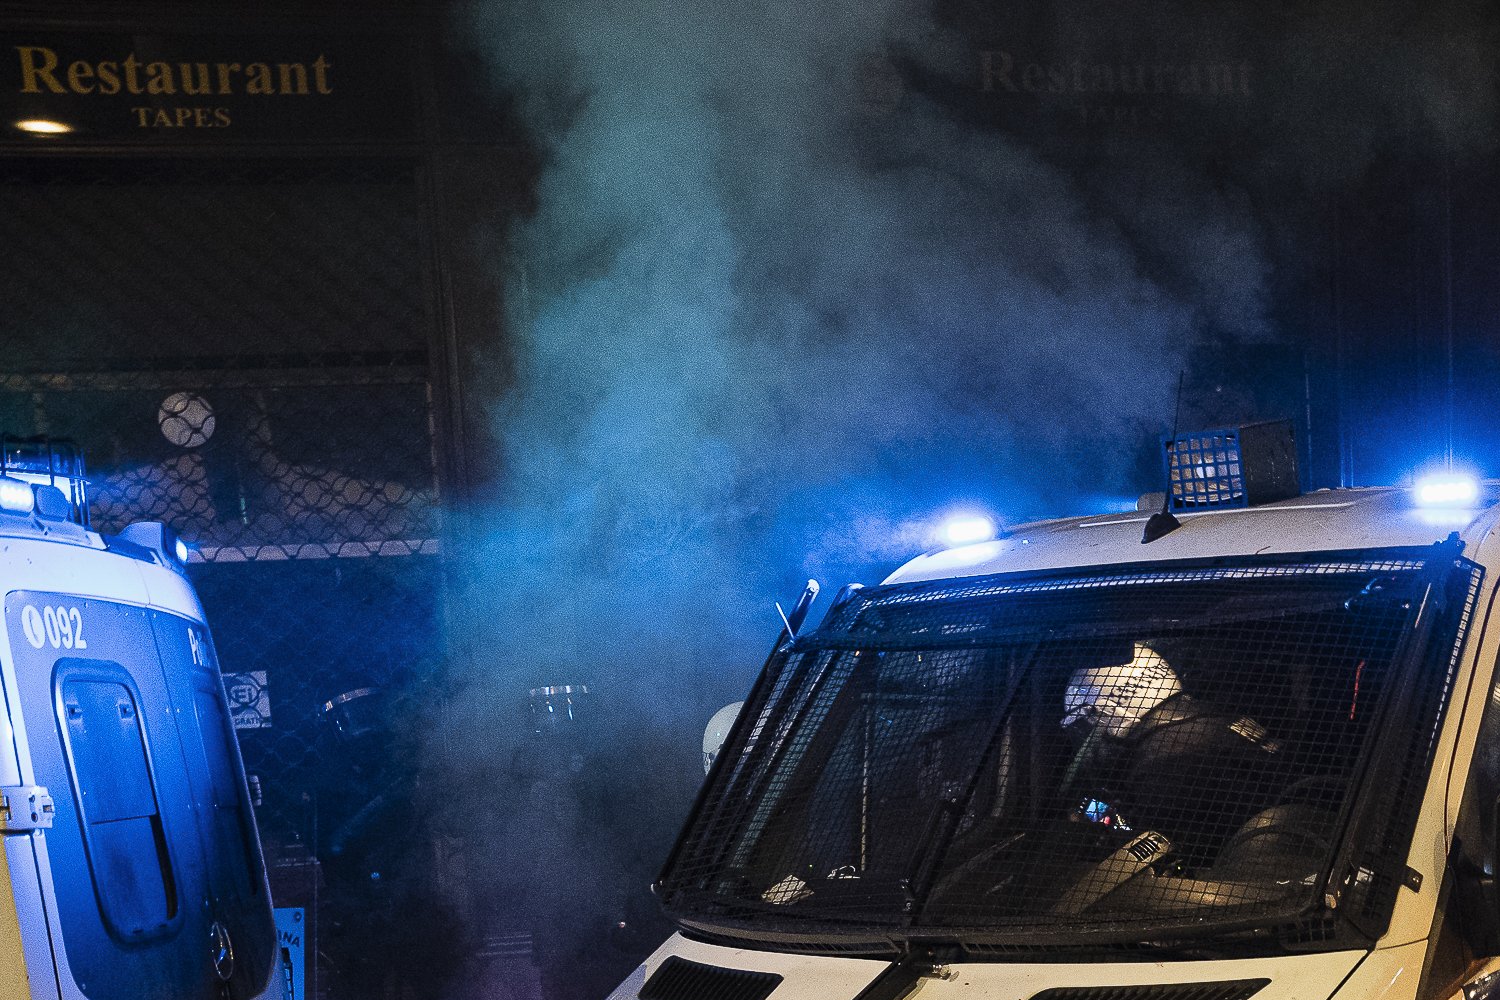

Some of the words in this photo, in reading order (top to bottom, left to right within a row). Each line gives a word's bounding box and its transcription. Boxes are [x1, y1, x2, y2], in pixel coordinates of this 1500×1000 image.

[16, 45, 334, 95] Restaurant
[978, 50, 1255, 97] Restaurant
[131, 106, 232, 129] TAPES
[43, 605, 88, 649] 092
